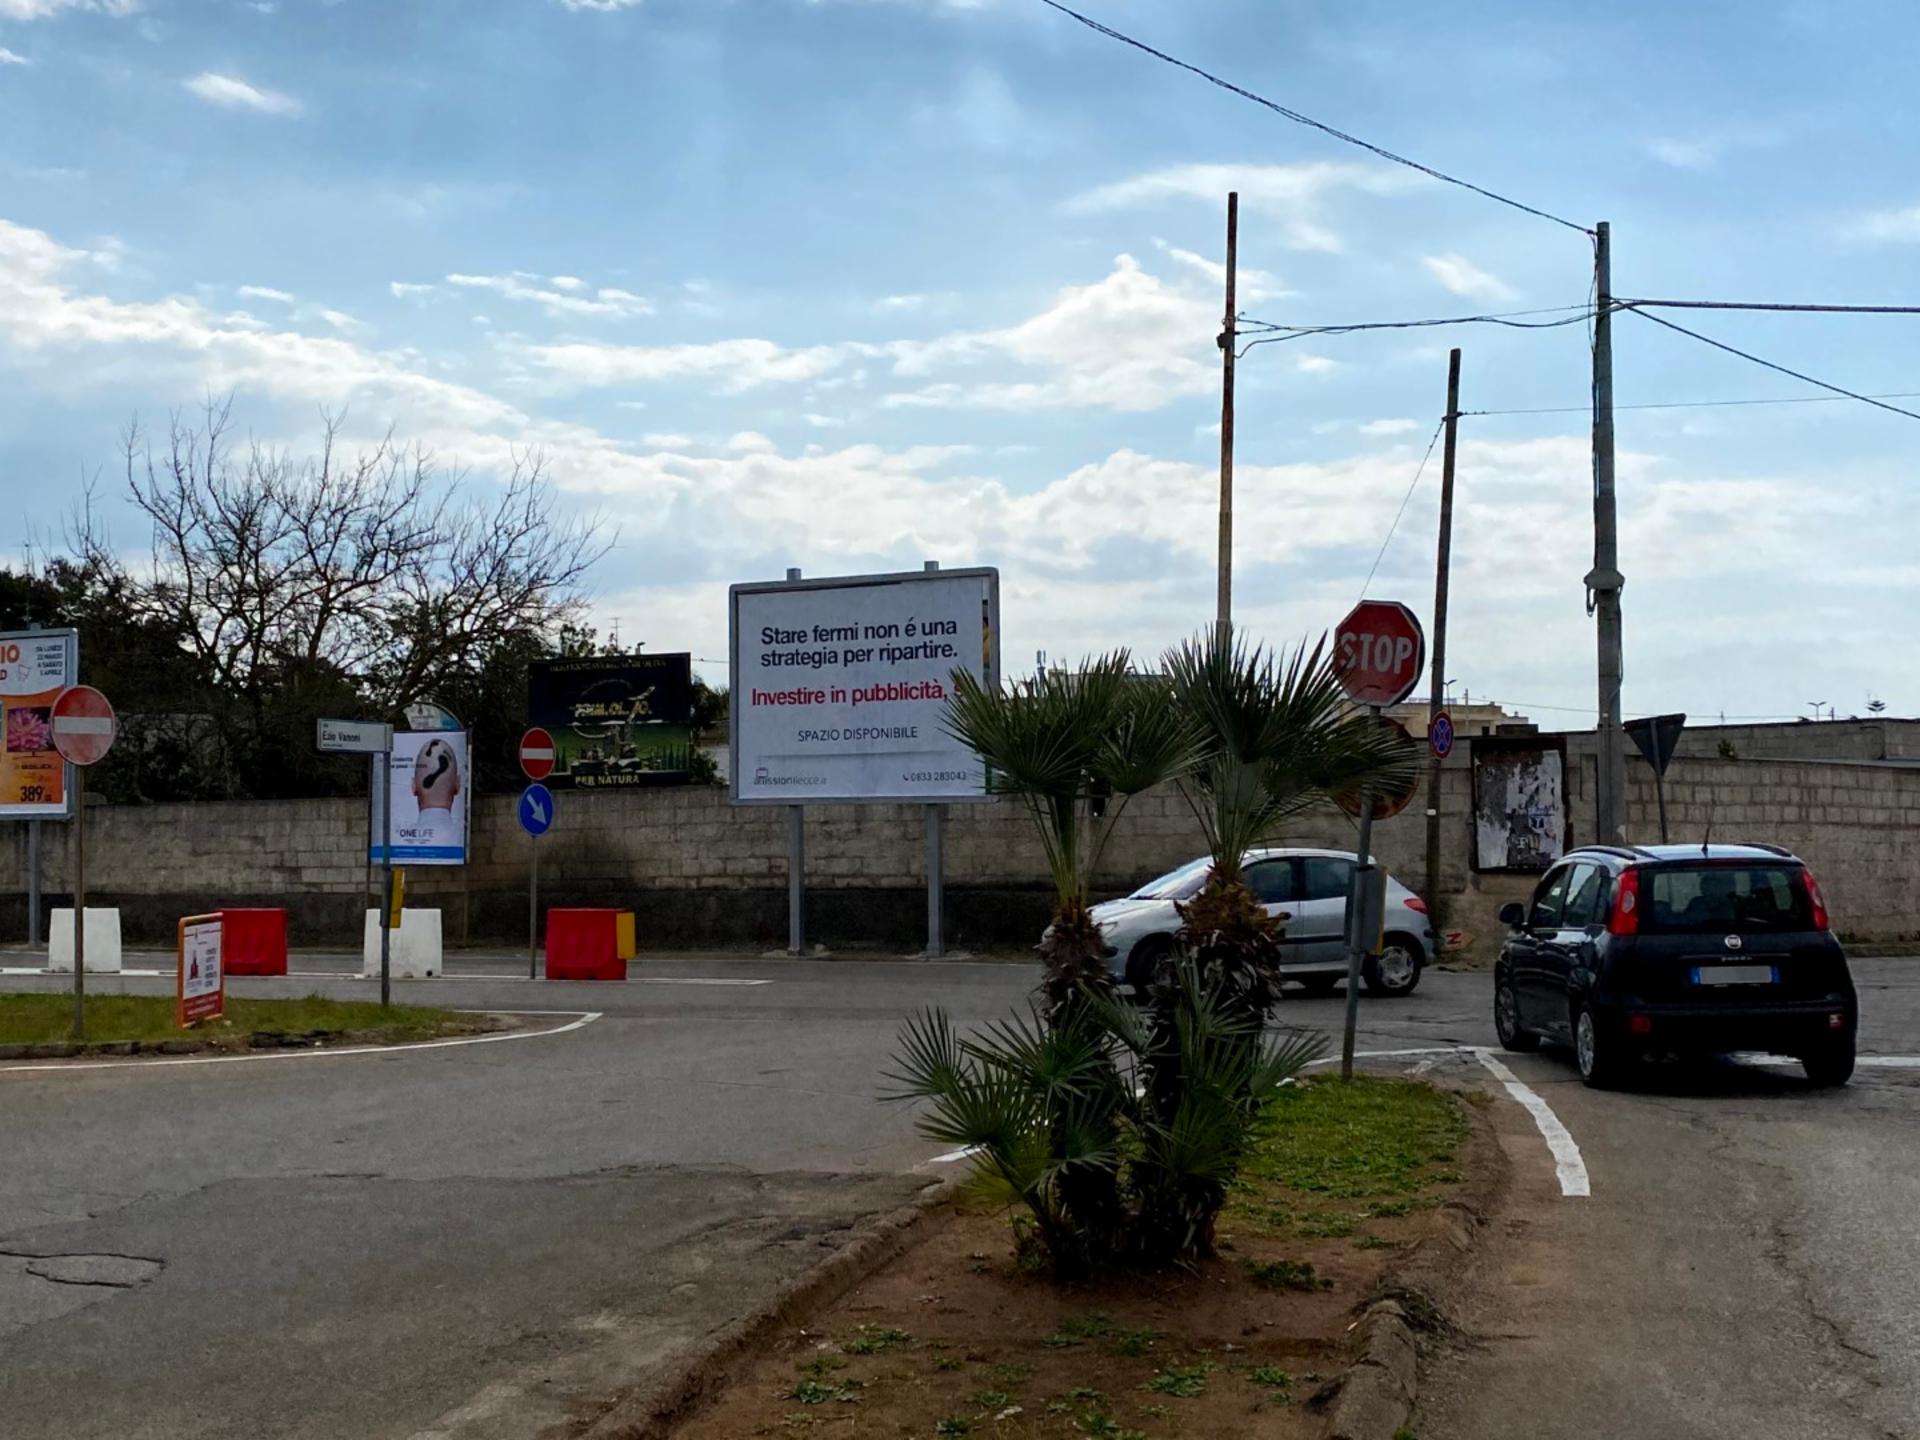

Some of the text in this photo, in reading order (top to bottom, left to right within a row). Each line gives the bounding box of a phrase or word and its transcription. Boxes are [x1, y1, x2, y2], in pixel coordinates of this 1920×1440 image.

[761, 626, 808, 645] Stare
[812, 622, 859, 643] fermi
[864, 623, 899, 640] non
[921, 620, 957, 637] una
[761, 641, 958, 669] strategia per ripartire.
[1340, 631, 1413, 675] STOP
[752, 688, 825, 706] Investire
[831, 684, 846, 703] in
[852, 678, 948, 707] pubblicità,
[798, 726, 919, 742] SPAZIO DISPONIBILE
[597, 774, 640, 785] NATURA
